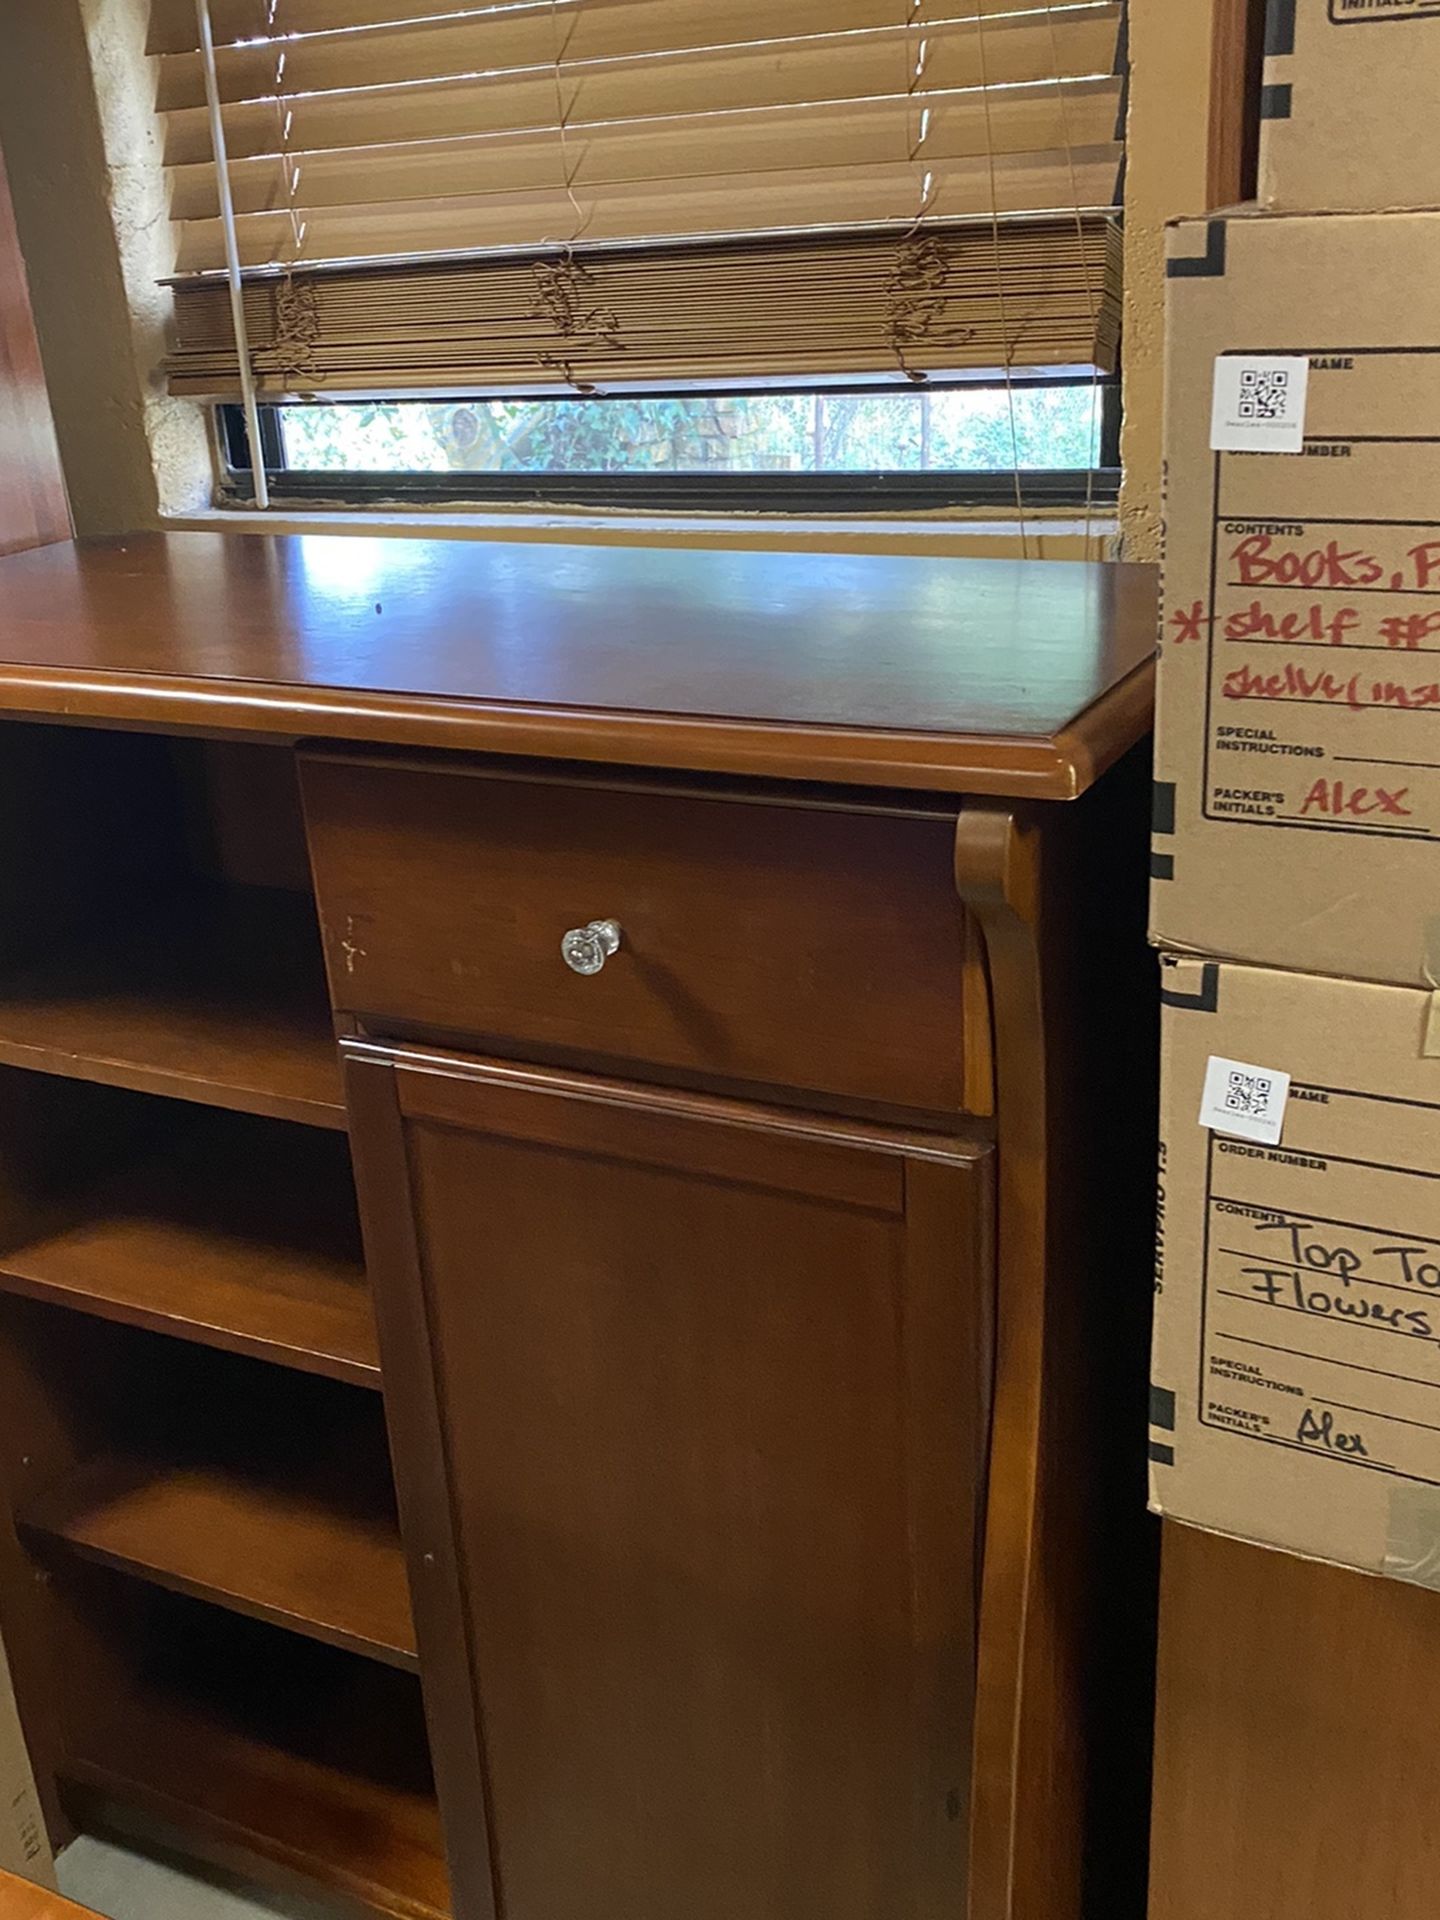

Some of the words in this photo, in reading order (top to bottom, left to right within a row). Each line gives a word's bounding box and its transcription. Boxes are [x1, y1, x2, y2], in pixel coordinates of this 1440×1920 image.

[1309, 358, 1354, 370] NAME
[1224, 523, 1304, 536] CONTENTS
[1224, 601, 1361, 645] shelf
[1217, 726, 1276, 740] SPECIAL
[1216, 740, 1325, 758] INSTRUCTIONS
[1214, 787, 1285, 804] PACKER'S
[1300, 778, 1412, 816] Alex
[1213, 801, 1275, 816] INITIALS
[1289, 1089, 1329, 1104] NAME
[1218, 1142, 1265, 1160] ORDER
[1267, 1152, 1328, 1172] NUMBER
[1215, 1202, 1286, 1224] CONTENTS
[1255, 1223, 1362, 1287] Top
[1241, 1268, 1433, 1337] Flowers
[1210, 1356, 1263, 1376] SPECIAL
[1210, 1366, 1304, 1397] INSTRUCTIONS
[1208, 1401, 1270, 1426] PACKER'S
[1208, 1412, 1262, 1434] INITIALS
[1296, 1408, 1369, 1456] Alex
